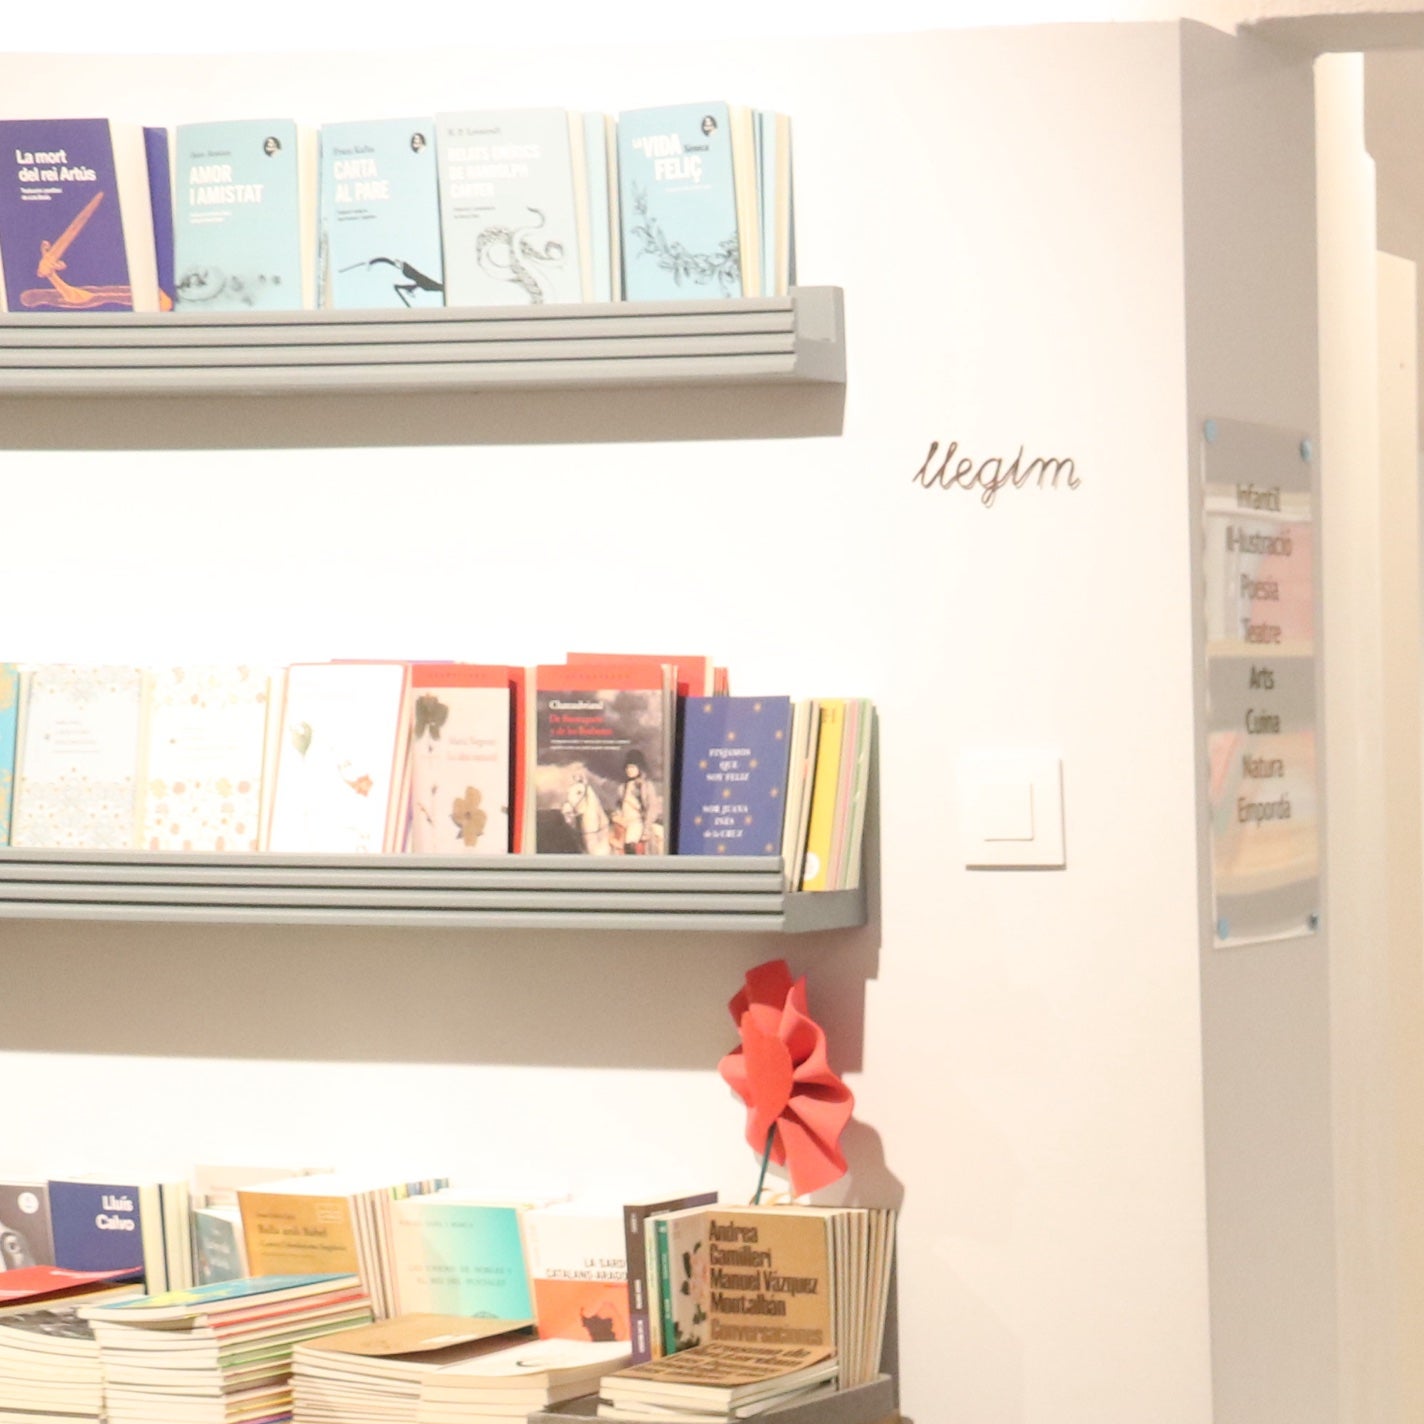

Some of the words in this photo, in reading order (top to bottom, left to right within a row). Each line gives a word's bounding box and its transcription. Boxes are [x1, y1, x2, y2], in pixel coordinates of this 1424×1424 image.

[16, 149, 32, 164] La
[36, 149, 67, 165] mort
[643, 134, 682, 158] VIDA
[19, 167, 39, 182] del
[60, 165, 96, 182] Artús
[190, 165, 232, 185] AMOR
[334, 159, 378, 181] CARTA
[655, 157, 703, 184] FELIÇ
[198, 184, 264, 205] AMISTAT
[336, 182, 353, 202] AL
[356, 180, 390, 201] PARE
[911, 441, 1082, 508] llegim
[1237, 484, 1281, 512] Infantil
[1240, 574, 1280, 601] Poesia
[1240, 618, 1282, 644] Teatre
[1248, 666, 1275, 690] Arts
[1245, 708, 1281, 734] Cuina
[1242, 753, 1285, 779] Natura
[1238, 794, 1292, 828] Empordà
[102, 1195, 134, 1212] Lluís
[96, 1214, 135, 1231] Calvo
[709, 1220, 758, 1243] Andrea
[710, 1243, 772, 1268] Camilleri
[711, 1268, 761, 1291] Manuel
[764, 1271, 819, 1297] Vázquez
[711, 1292, 787, 1316] Montalbán
